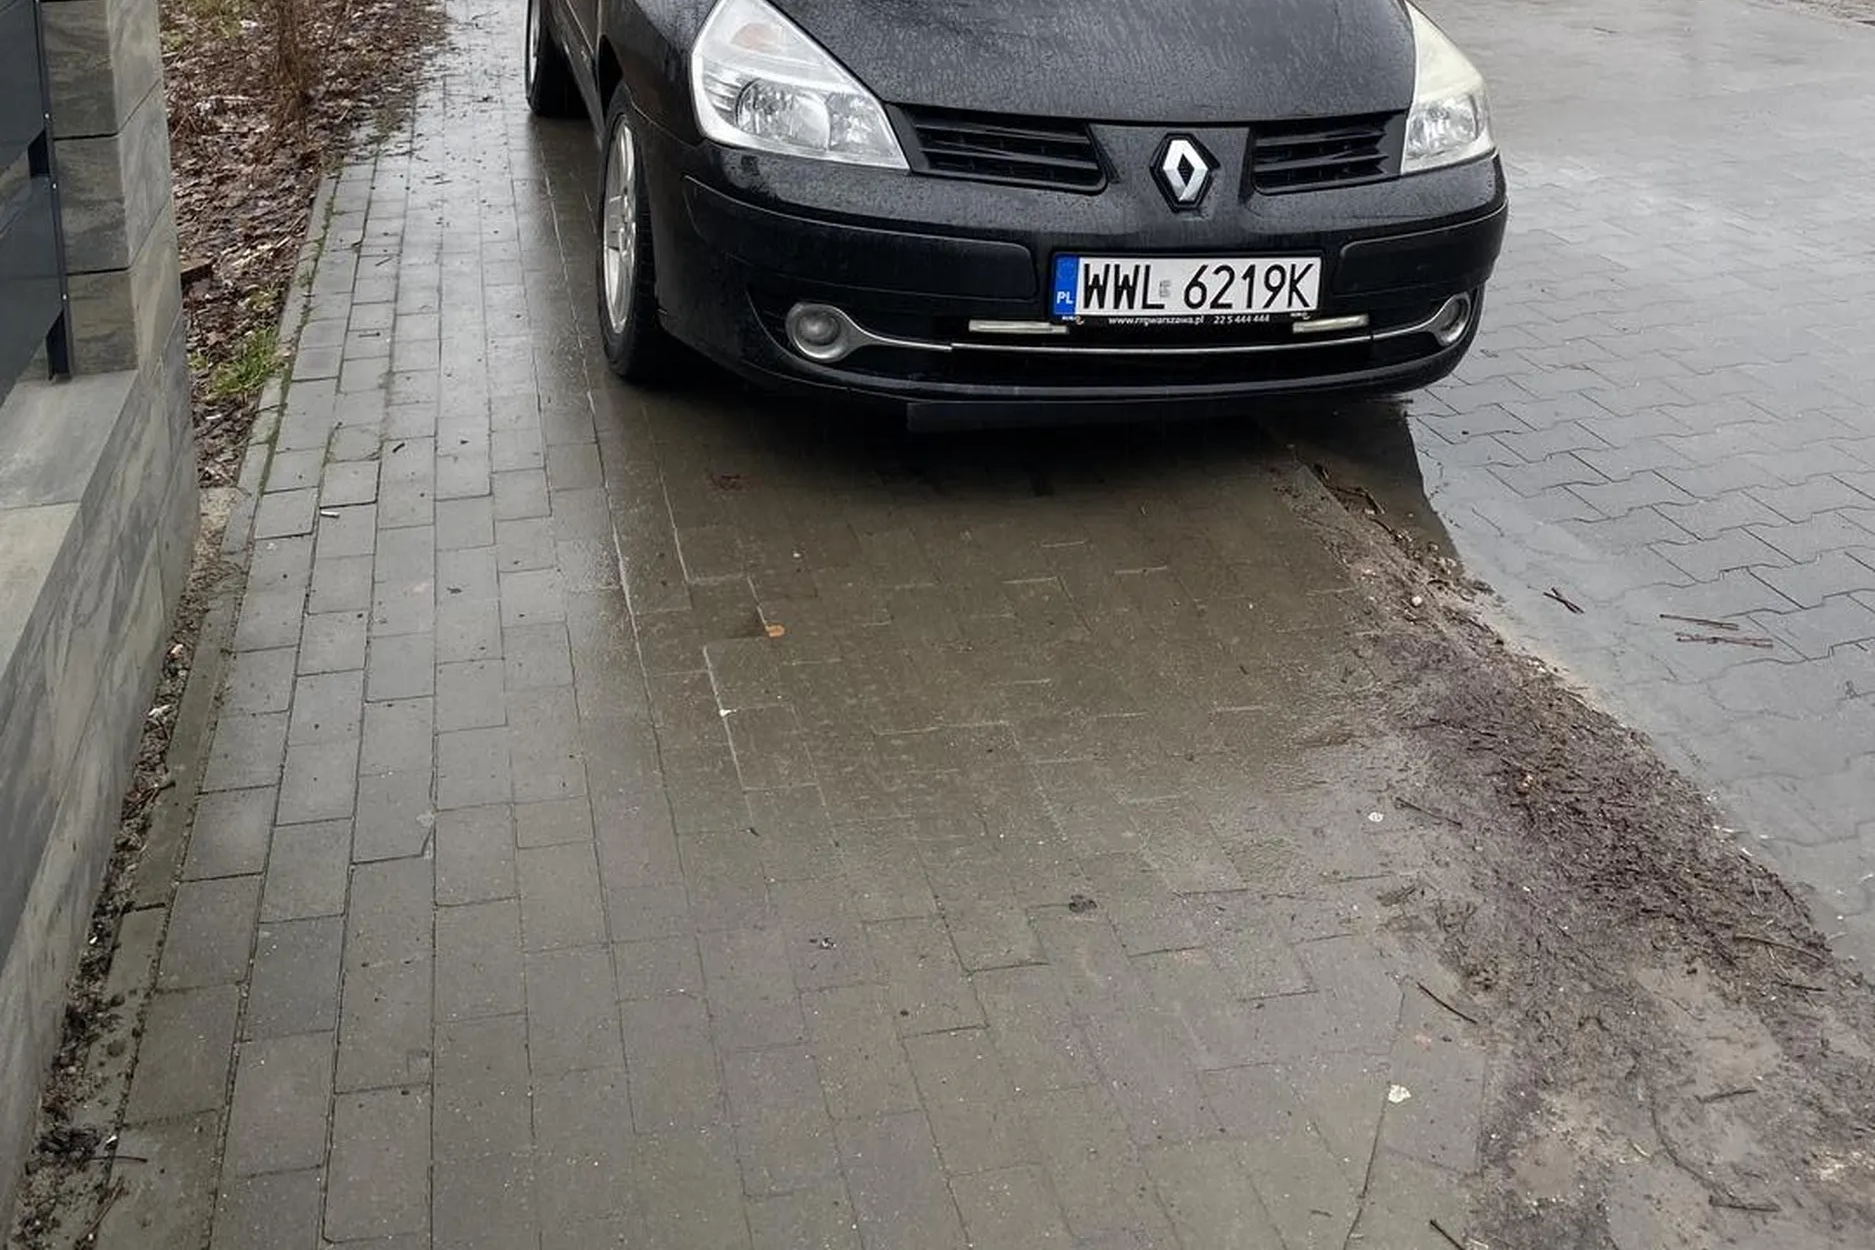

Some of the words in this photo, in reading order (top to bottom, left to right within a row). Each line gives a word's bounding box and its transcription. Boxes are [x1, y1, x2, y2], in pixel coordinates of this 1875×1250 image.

[1056, 290, 1074, 305] PL
[1083, 263, 1165, 310] WWL
[1183, 263, 1315, 310] 6219K
